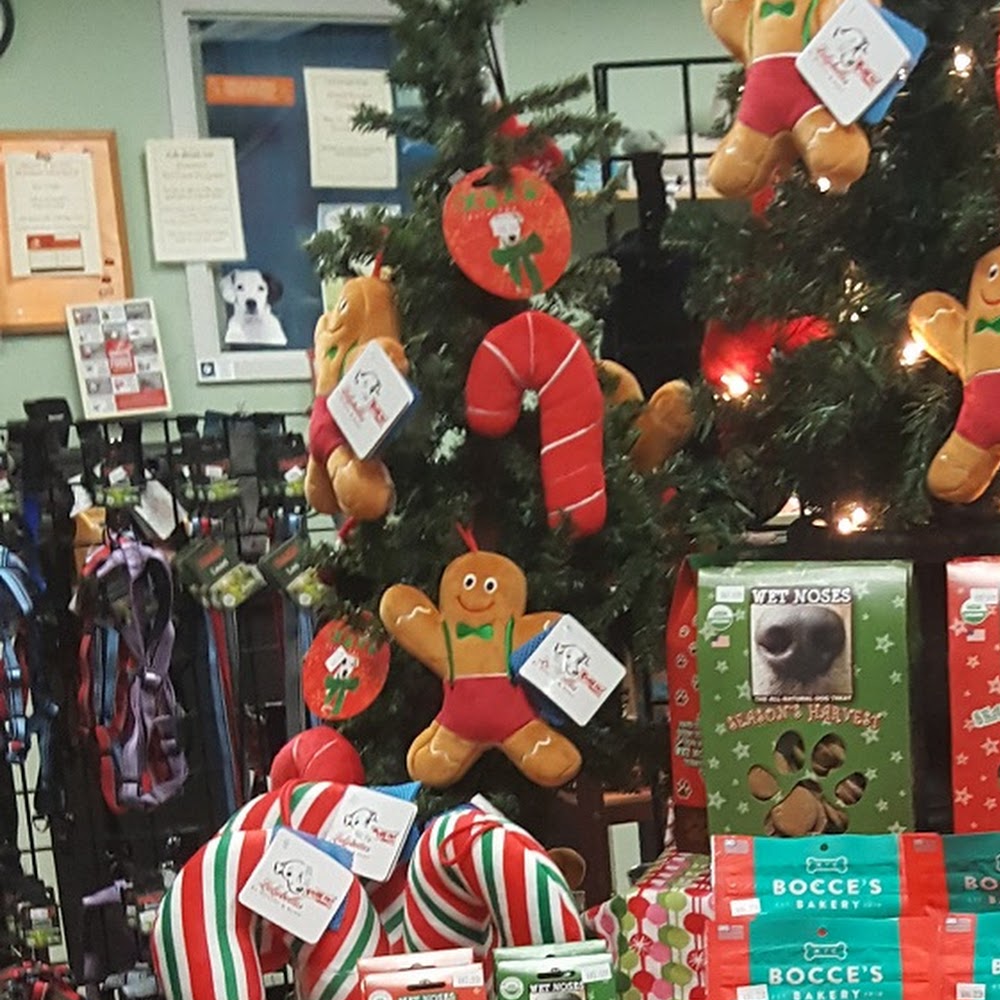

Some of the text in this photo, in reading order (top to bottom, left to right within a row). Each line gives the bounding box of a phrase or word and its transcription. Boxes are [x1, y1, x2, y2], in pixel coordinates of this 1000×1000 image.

[752, 587, 852, 604] WET NOSES
[726, 703, 883, 731] SEASON'S HARVEST
[773, 879, 882, 896] BOCCE'S
[796, 900, 860, 910] BAKERY
[769, 966, 884, 986] BOCCE'S
